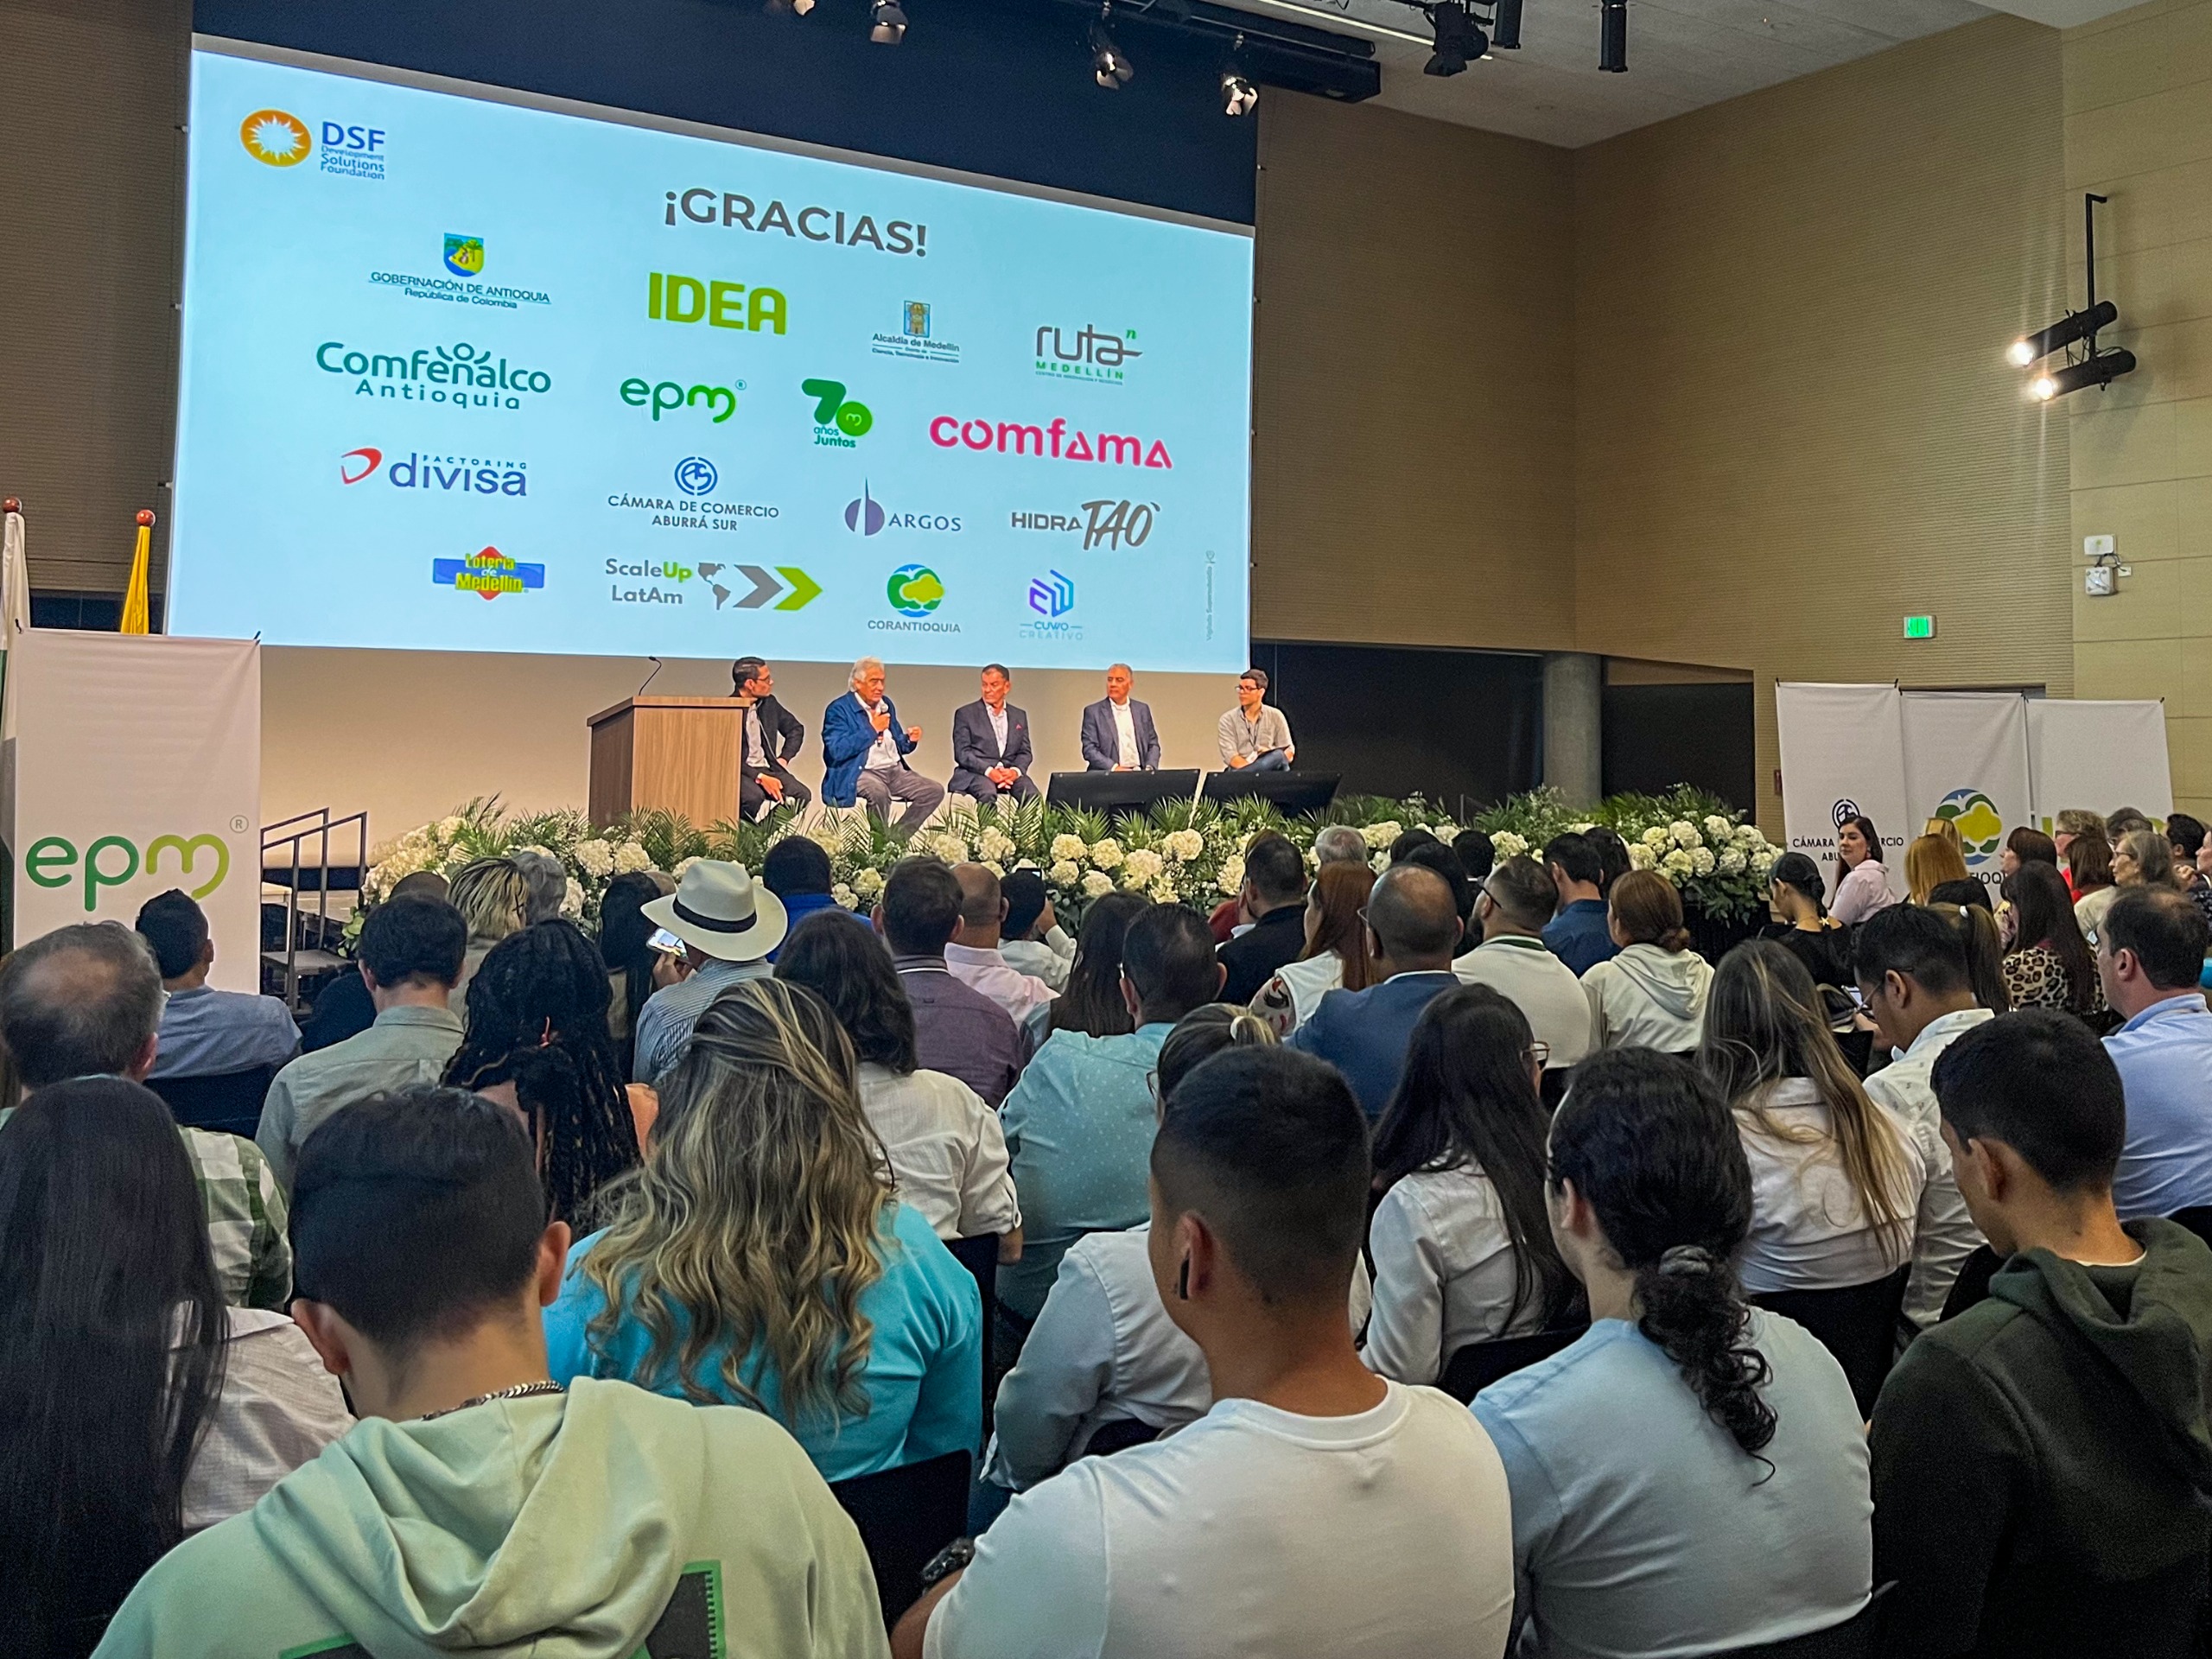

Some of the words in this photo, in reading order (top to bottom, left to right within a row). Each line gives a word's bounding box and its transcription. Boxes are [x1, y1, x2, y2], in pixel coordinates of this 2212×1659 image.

[321, 121, 385, 152] DSF
[321, 153, 385, 173] Solutions
[321, 161, 385, 180] Foundation
[664, 187, 927, 257] ¡GRACIAS!
[371, 271, 463, 292] GOBERNACIÓN
[467, 283, 483, 295] DE
[486, 286, 550, 303] ANTIOQUIA
[455, 294, 470, 303] de
[472, 296, 518, 309] Colombia
[648, 271, 787, 335] IDEA
[910, 338, 922, 347] de
[1036, 323, 1143, 367] ruta
[316, 342, 551, 393] Comfenalco
[355, 378, 519, 410] Antioquia
[620, 378, 736, 423] epm
[813, 434, 856, 448] Juntos
[930, 416, 1173, 469] comfama
[423, 454, 526, 469] FACTORING
[389, 452, 527, 497] divisa
[607, 493, 674, 511] CÁMARA
[679, 500, 696, 512] DE
[701, 502, 779, 518] COMERCIO
[652, 515, 708, 529] ABURRÁ
[712, 518, 737, 531] SUR
[888, 513, 962, 531] ARGOS
[480, 565, 498, 577] de
[606, 558, 692, 583] ScaleUp
[612, 585, 683, 604] LatAm
[868, 620, 961, 633] CORANTIOQUIA
[1020, 629, 1084, 640] CREATIVO
[1793, 836, 1835, 848] CÁMARA
[1880, 836, 1904, 847] RCIO
[1821, 851, 1840, 861] ABU
[26, 833, 230, 912] epm
